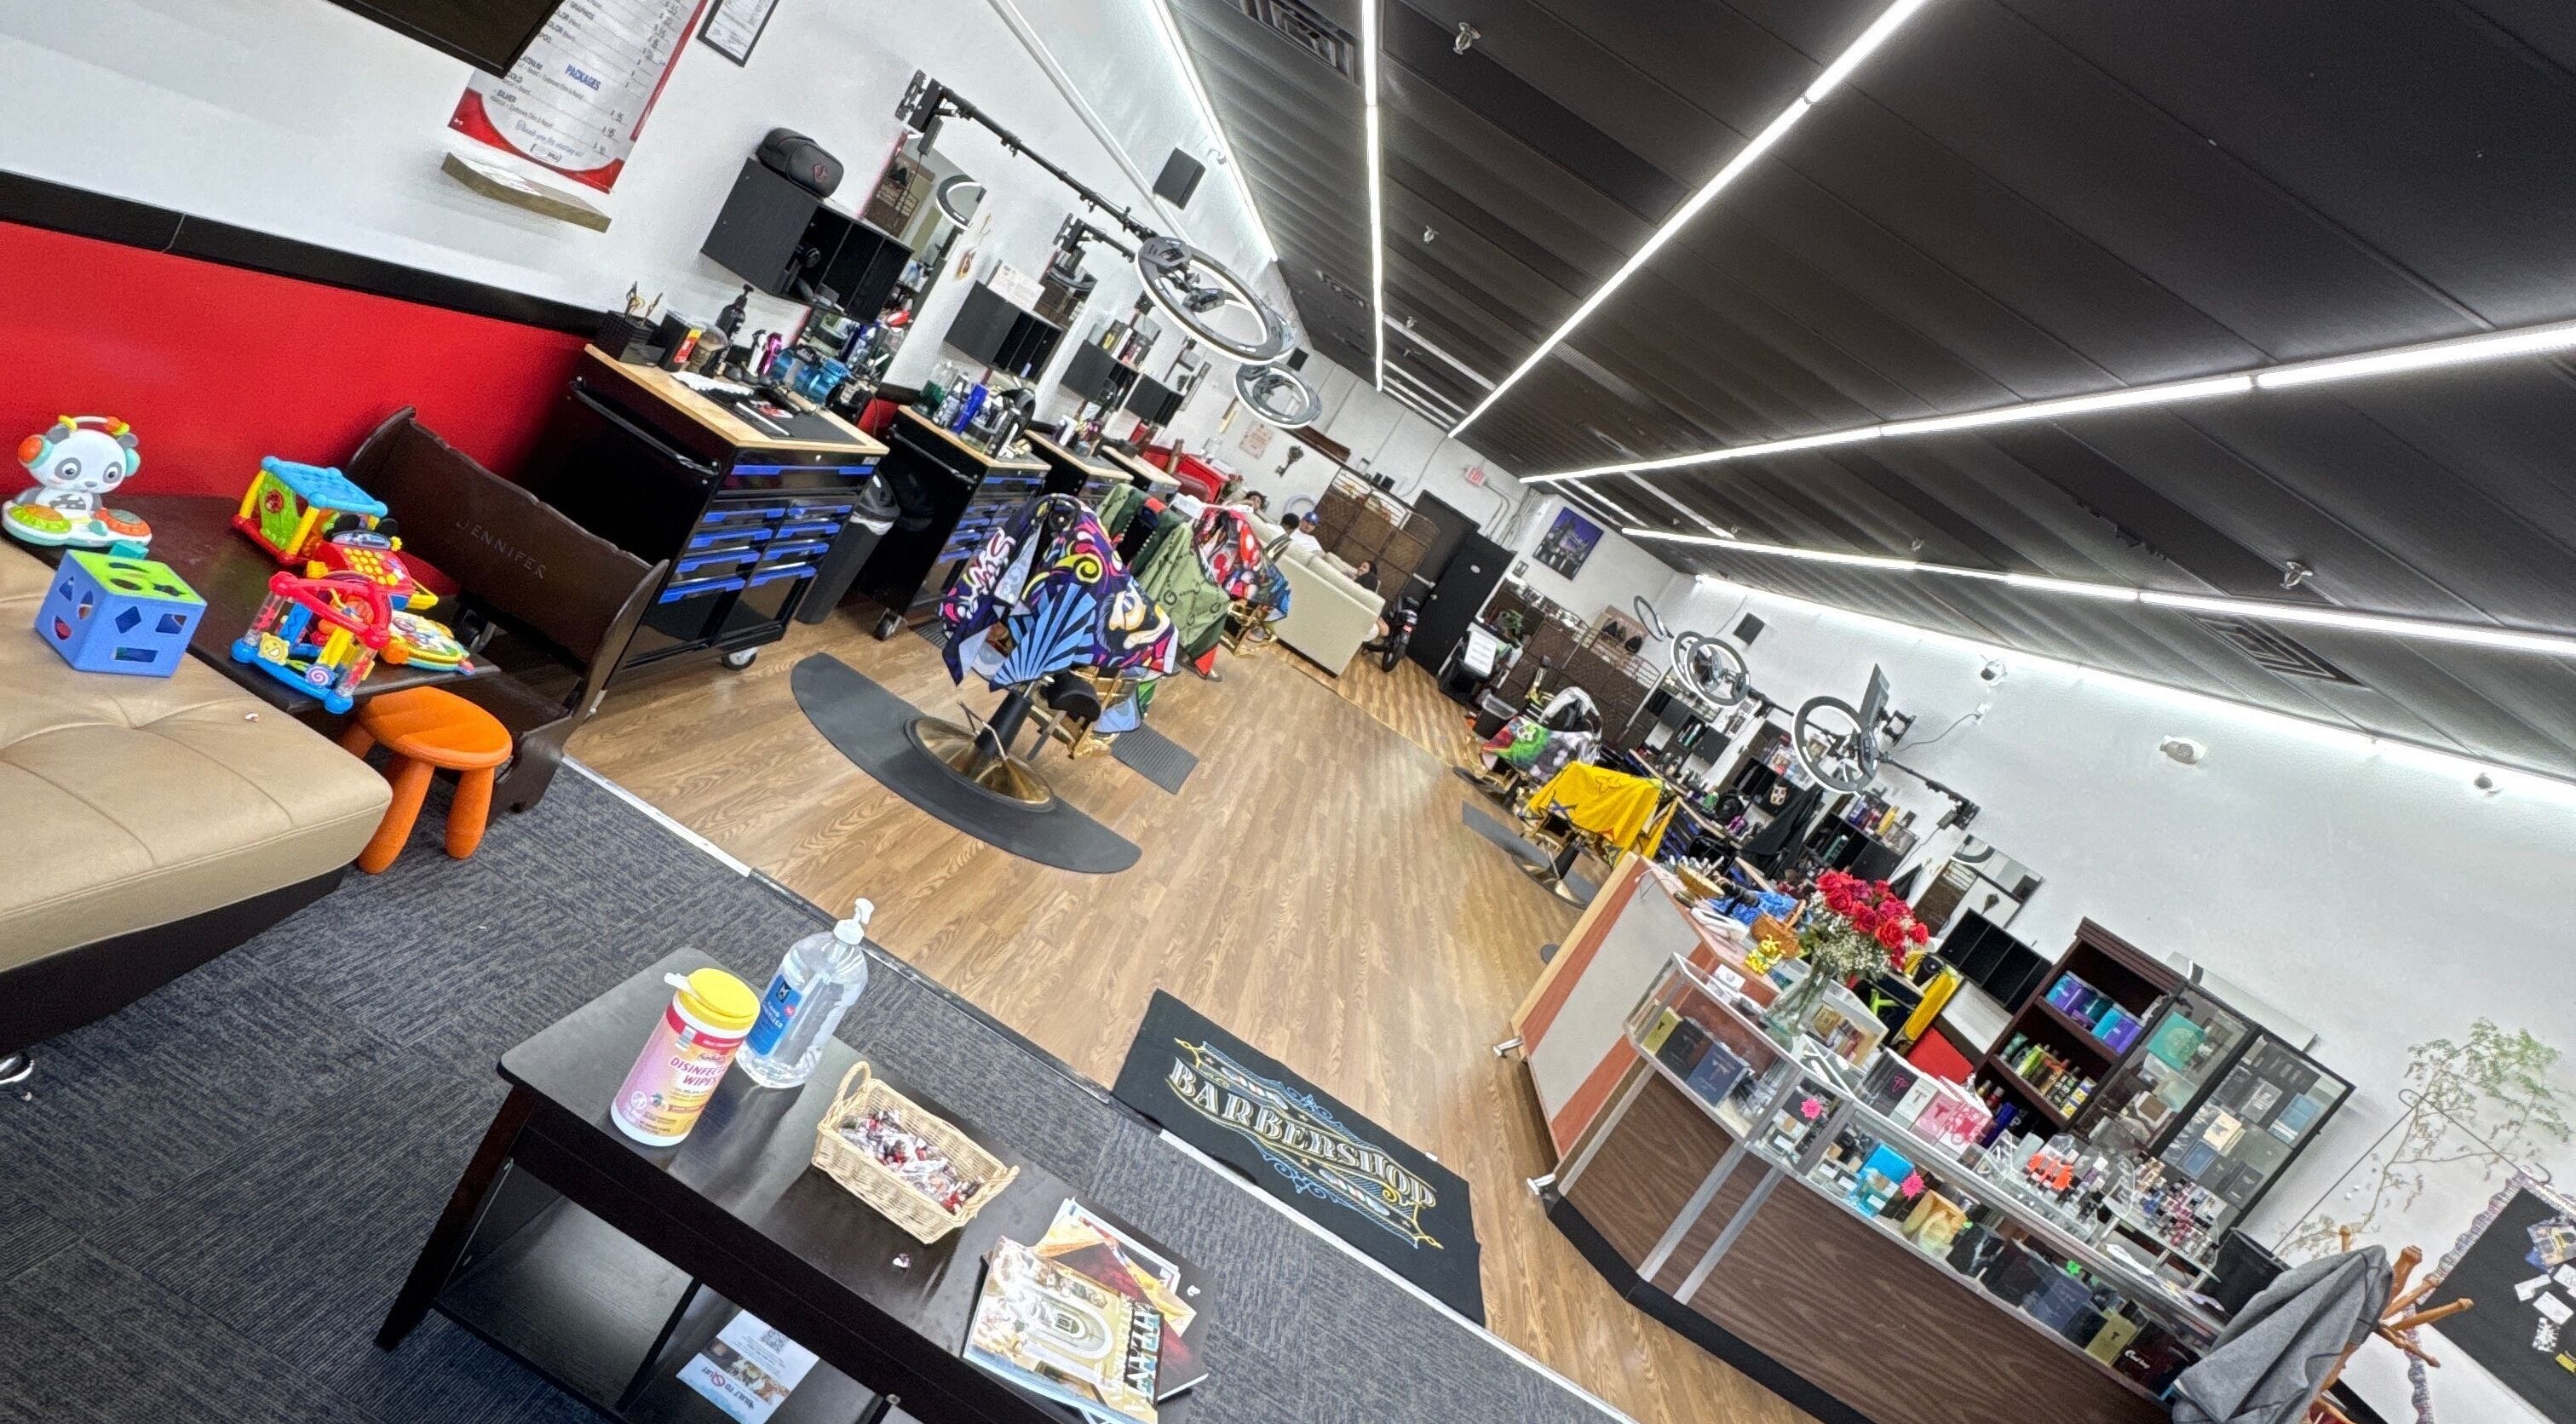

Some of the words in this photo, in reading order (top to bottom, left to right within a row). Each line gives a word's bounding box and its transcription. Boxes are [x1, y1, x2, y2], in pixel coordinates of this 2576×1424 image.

[548, 20, 563, 34] OLOR
[519, 55, 543, 70] LATINUM
[564, 63, 601, 91] PACKAGES
[456, 519, 548, 581] JENNIFER
[1167, 1057, 1437, 1209] BARBERSHOP
